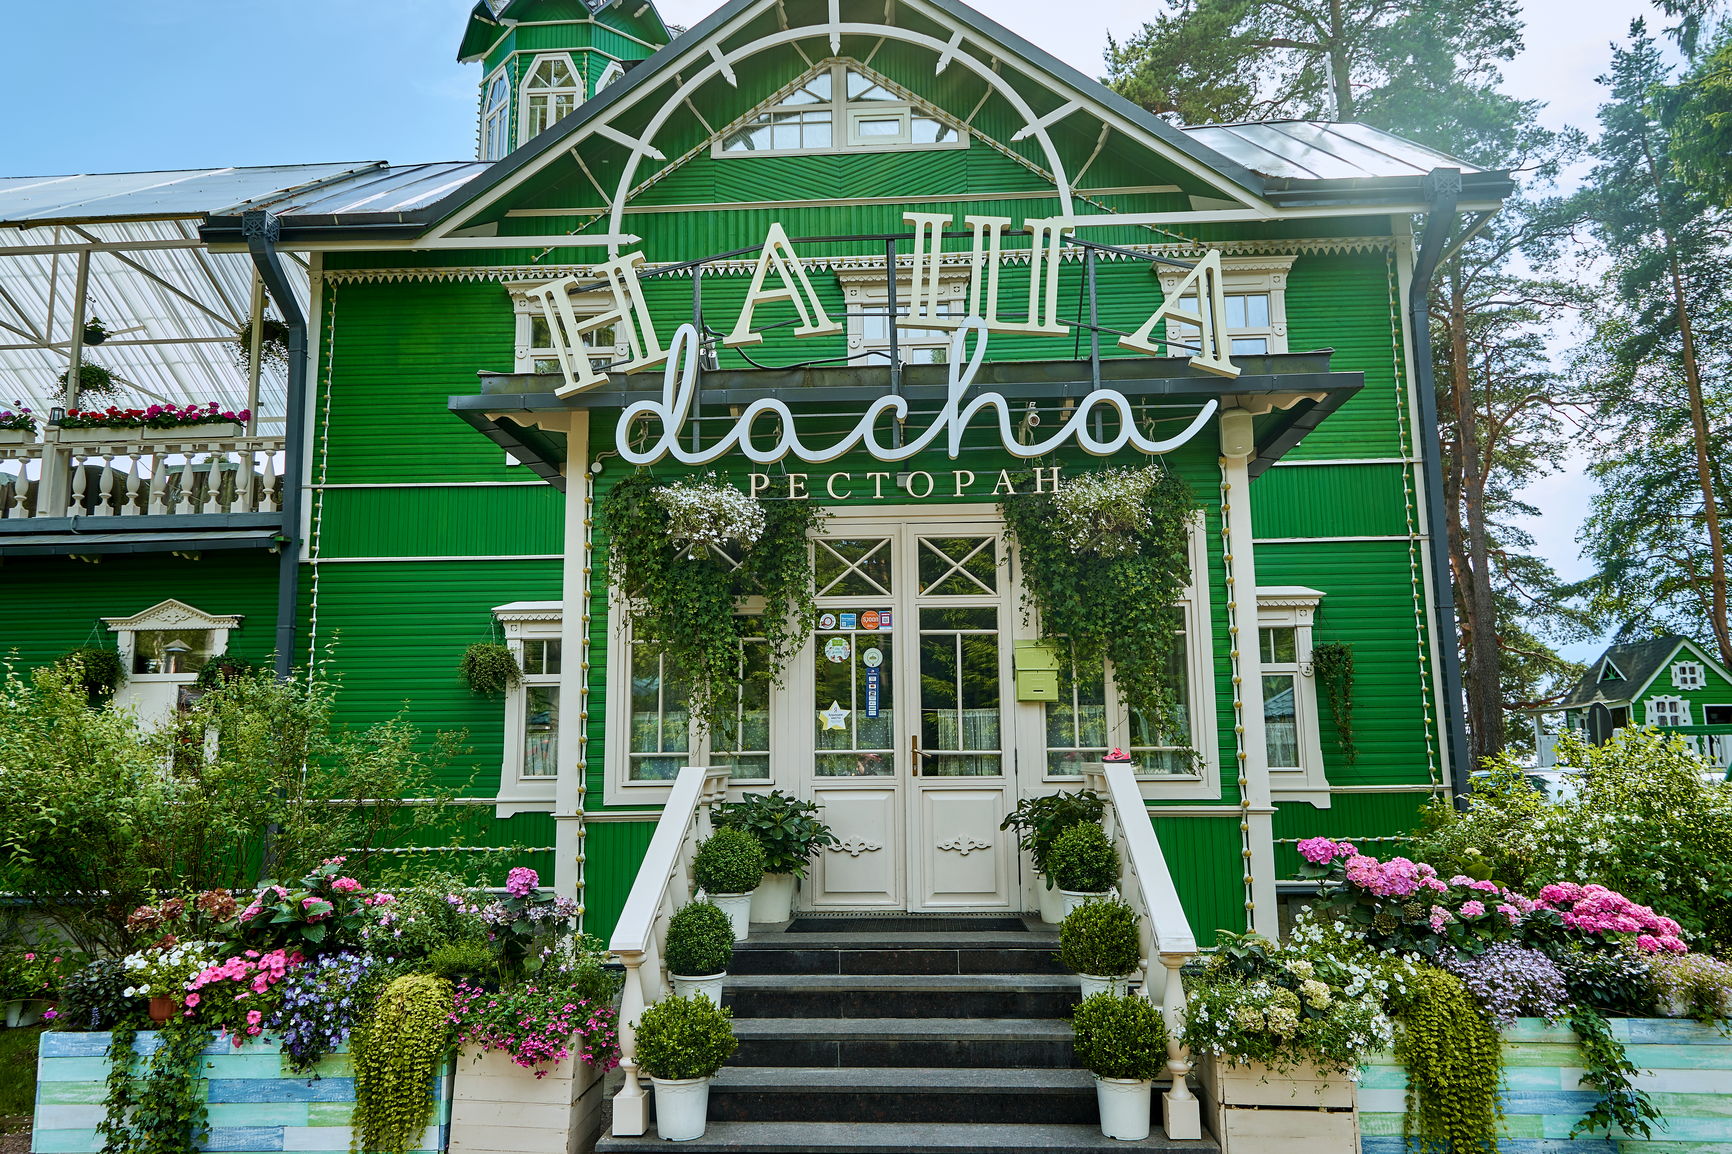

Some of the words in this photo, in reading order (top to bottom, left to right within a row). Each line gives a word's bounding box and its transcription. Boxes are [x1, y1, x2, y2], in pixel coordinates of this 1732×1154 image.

[525, 212, 1242, 400] НАША
[615, 316, 1218, 465] dacha
[748, 466, 1062, 500] РЕСТОРАН
